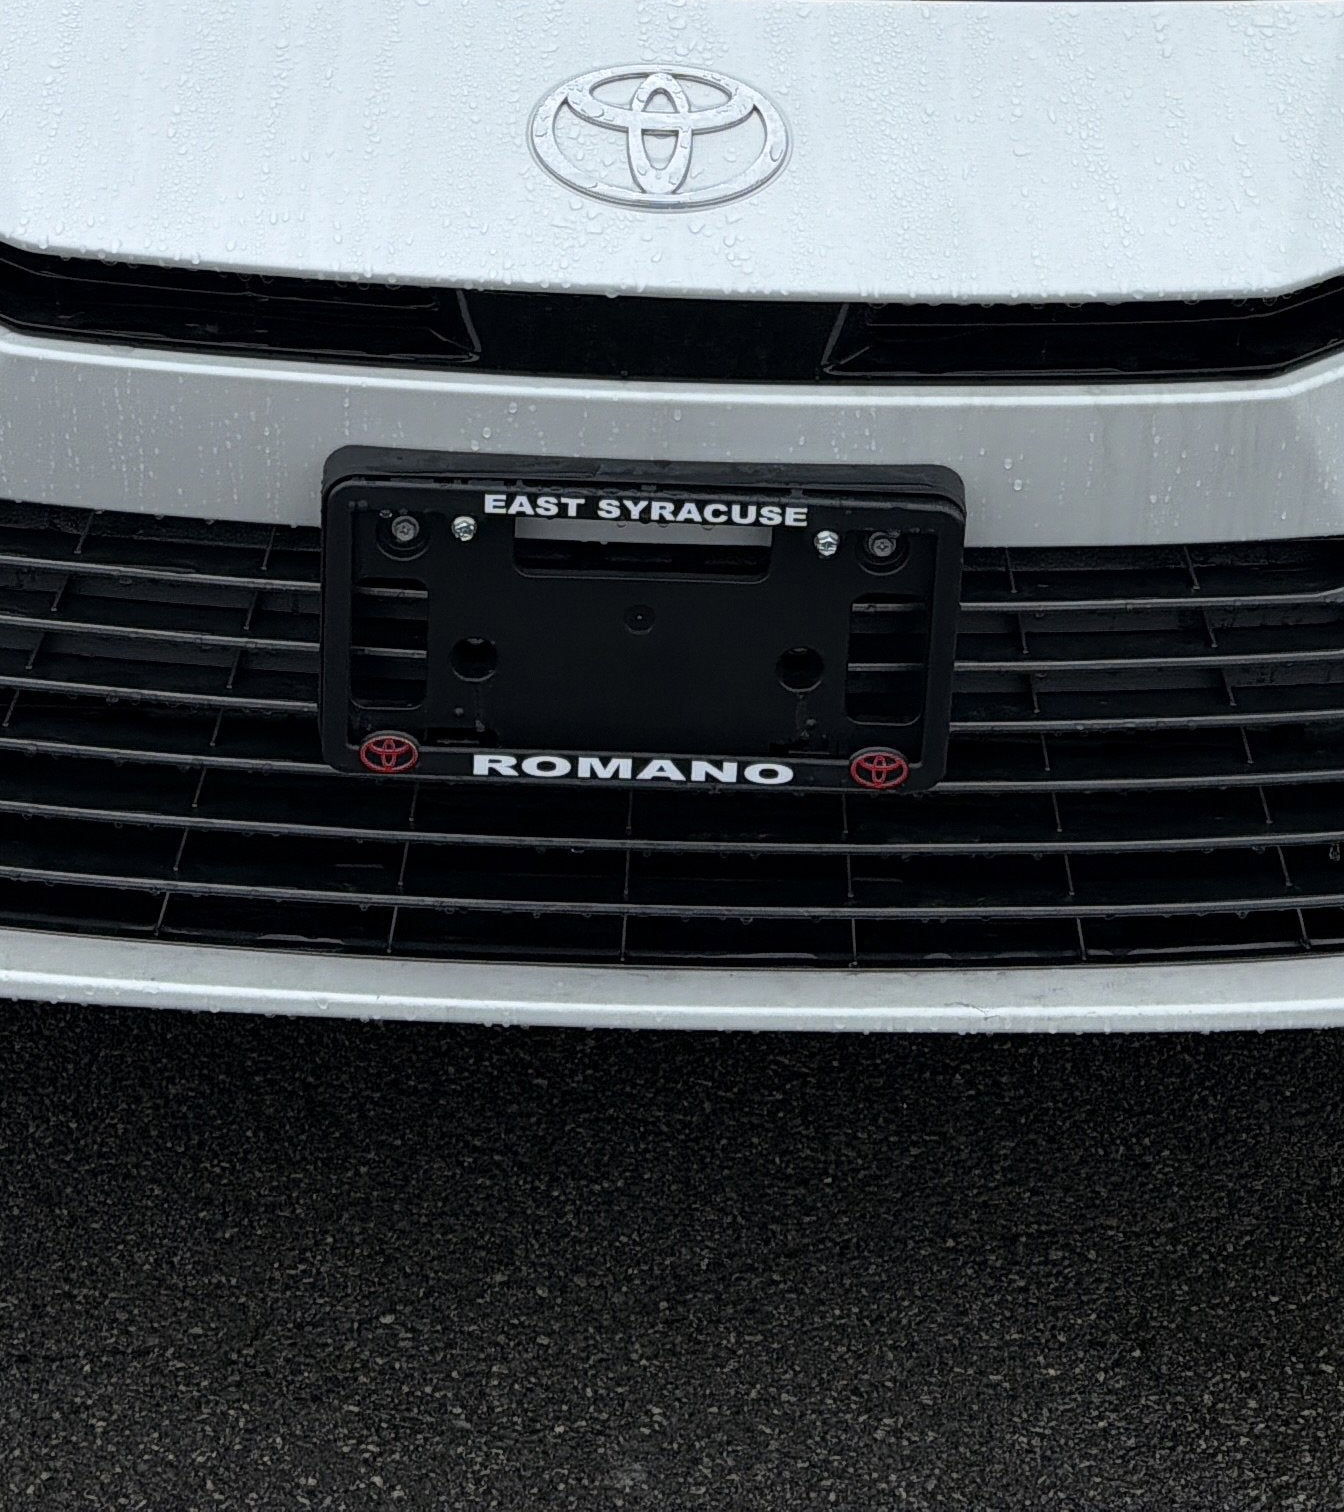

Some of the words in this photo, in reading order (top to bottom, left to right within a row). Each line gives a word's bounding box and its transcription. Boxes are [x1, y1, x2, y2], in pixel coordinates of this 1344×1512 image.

[484, 494, 586, 517] EAST
[597, 499, 808, 527] SYRACUSE
[473, 754, 794, 785] ROMANO
